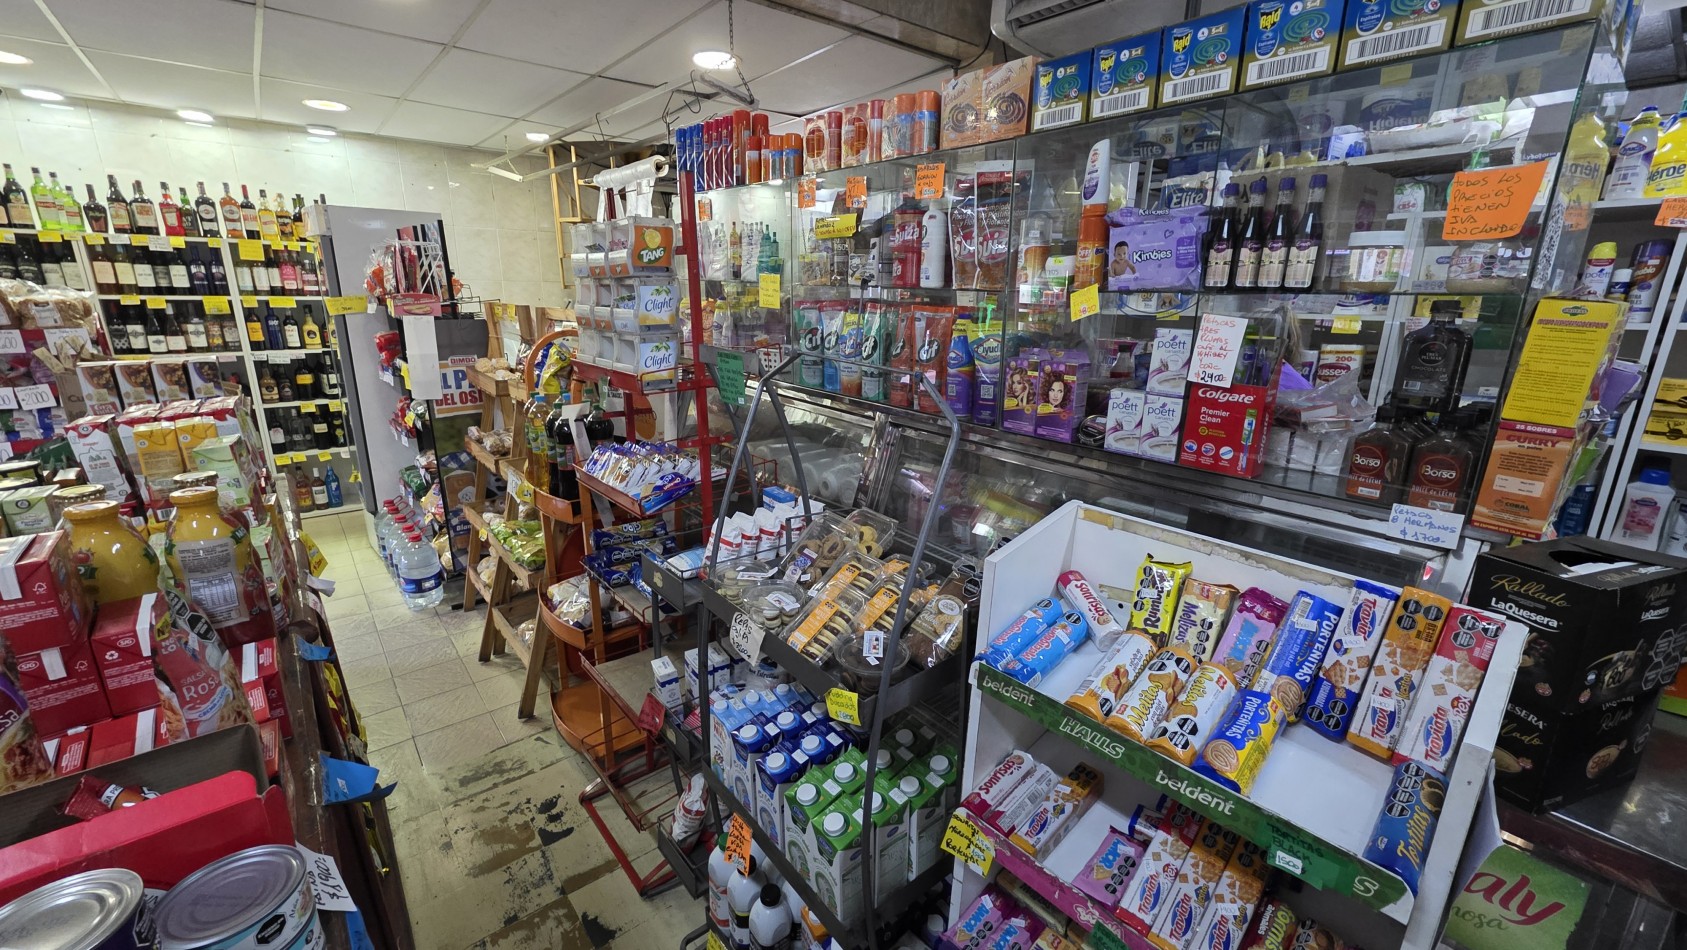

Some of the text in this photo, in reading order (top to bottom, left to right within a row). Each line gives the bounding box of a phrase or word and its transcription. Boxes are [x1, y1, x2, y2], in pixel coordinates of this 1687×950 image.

[1260, 7, 1282, 29] Raid
[1173, 35, 1191, 53] Raid
[1172, 187, 1204, 208] Elite
[895, 223, 920, 246] Suiza
[640, 248, 664, 262] TANG
[1132, 250, 1172, 264] Kimbies
[645, 297, 673, 314] Clight
[804, 329, 822, 350] Cif
[1157, 339, 1187, 350] poett
[644, 353, 672, 369] Clight
[1198, 387, 1257, 404] Colgate
[1111, 401, 1138, 413] poett
[1147, 405, 1177, 417] poett
[1201, 406, 1231, 417] Premier
[1200, 414, 1222, 424] Clean
[1515, 424, 1558, 435] 25 SOBRES
[1506, 434, 1560, 448] CURRY
[1074, 582, 1106, 618] Sonrisas
[1490, 573, 1572, 608] Rallado
[1175, 601, 1200, 643] Mellizas
[1491, 597, 1561, 630] LaQuesera
[982, 674, 1036, 707] beldent
[1181, 667, 1216, 713] Melitas
[1127, 681, 1164, 732] Melitas
[1371, 687, 1393, 740] Travita
[1452, 696, 1473, 719] Rex
[1059, 716, 1126, 759] HALLS
[1424, 704, 1449, 762] Traviata
[978, 757, 1017, 795] Sonrisas
[1155, 769, 1235, 816] beldent
[1024, 807, 1049, 840] Traviata
[1397, 805, 1432, 871] Tortitas
[1163, 862, 1178, 883] Rex
[1169, 892, 1193, 942] Traviata
